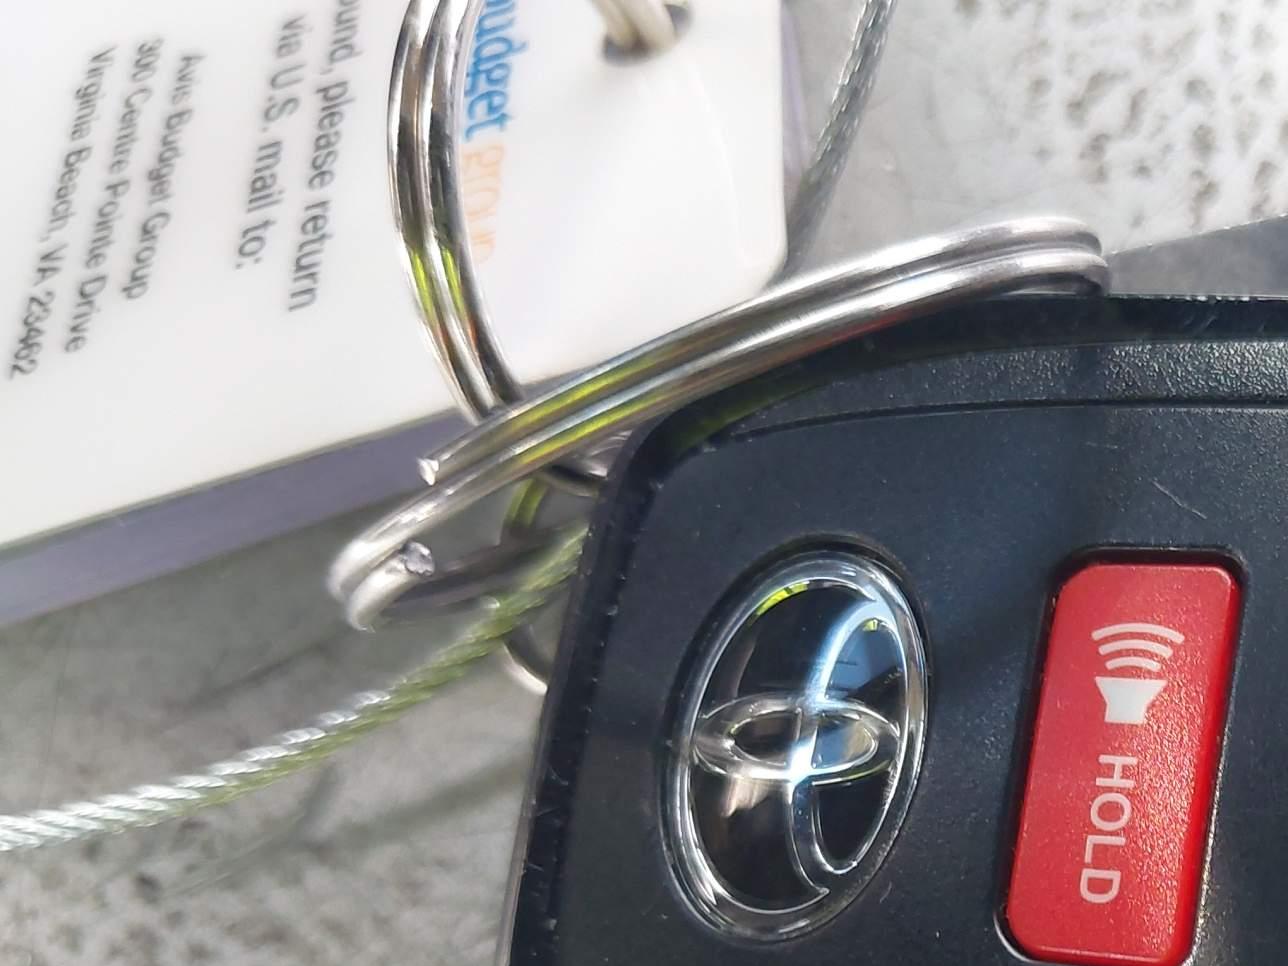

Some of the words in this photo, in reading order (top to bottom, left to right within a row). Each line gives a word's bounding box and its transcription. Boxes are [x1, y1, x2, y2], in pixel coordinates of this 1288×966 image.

[171, 54, 206, 105] Avis
[275, 15, 311, 58] via
[463, 0, 528, 141] udget
[69, 44, 118, 143] Virginia
[108, 87, 153, 174] Centre
[261, 63, 304, 132] U.S.
[304, 80, 356, 190] please
[38, 146, 93, 242] Beach,
[147, 109, 193, 207] Budget
[246, 140, 285, 213] mail
[32, 242, 70, 287] VA
[85, 180, 131, 269] Pointe
[121, 211, 171, 300] Group
[234, 219, 277, 269] to:
[288, 199, 333, 311] return
[8, 290, 56, 381] 23462
[64, 274, 108, 353] Drive
[1079, 755, 1139, 903] HOLD
